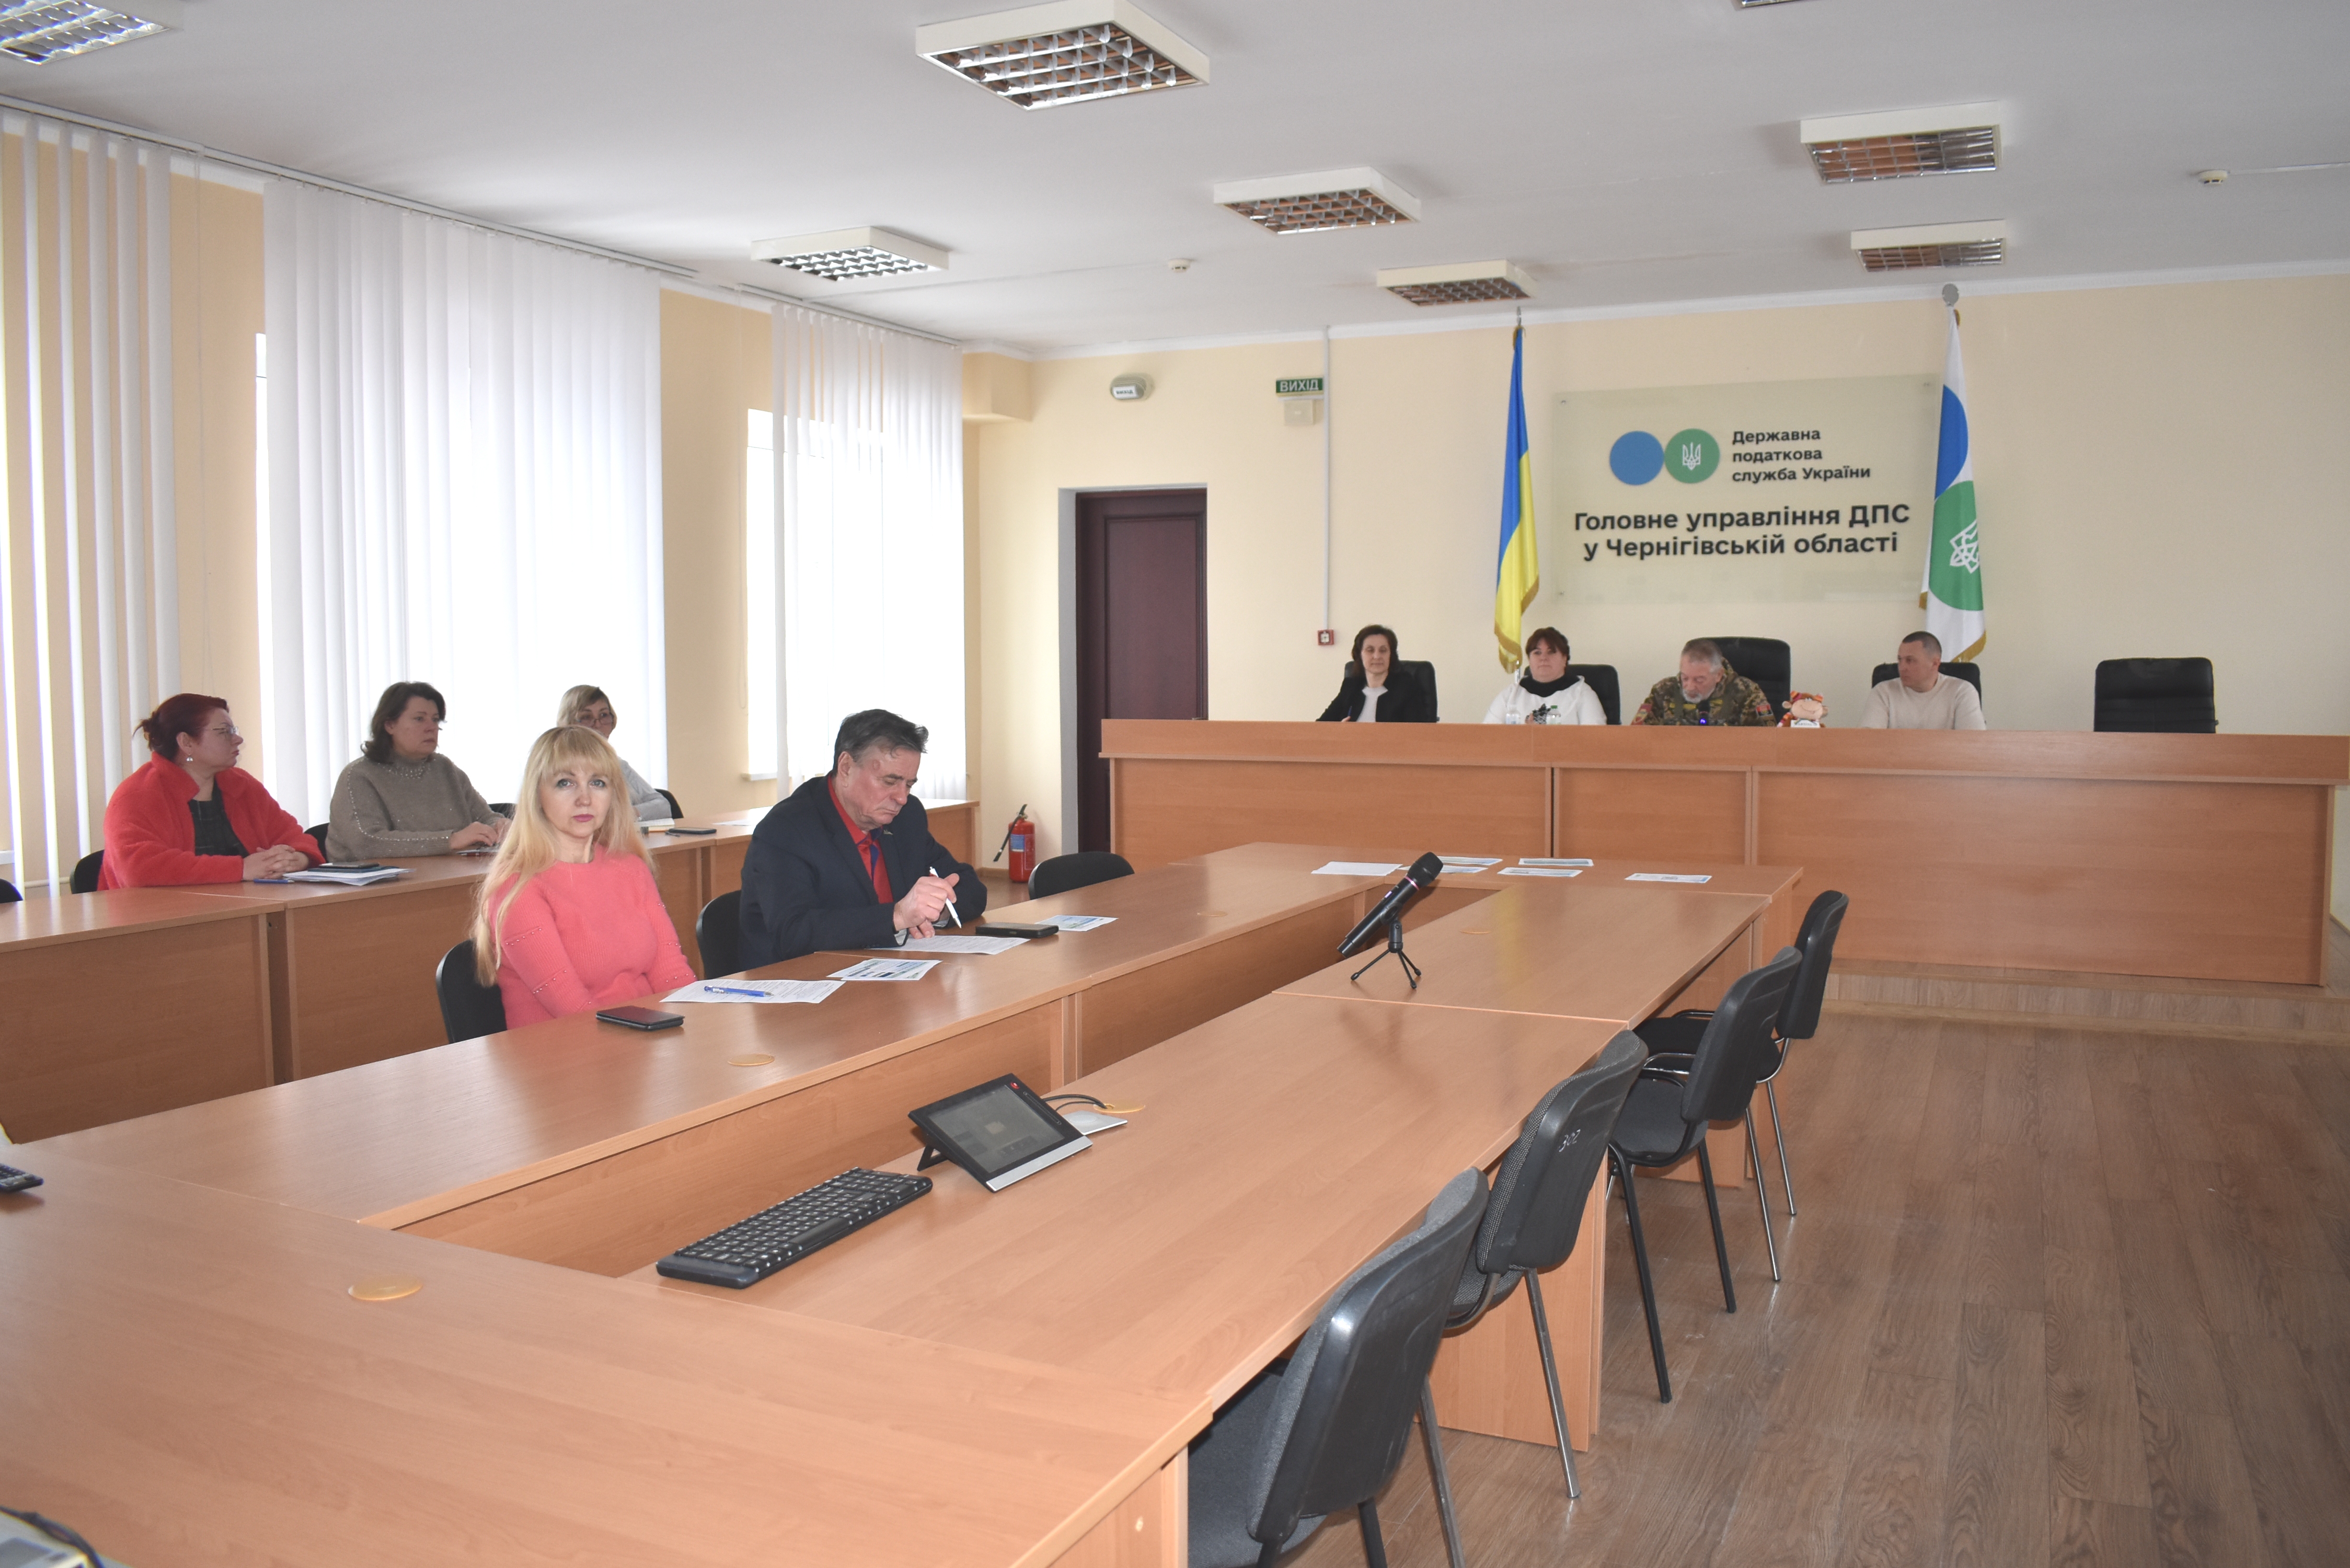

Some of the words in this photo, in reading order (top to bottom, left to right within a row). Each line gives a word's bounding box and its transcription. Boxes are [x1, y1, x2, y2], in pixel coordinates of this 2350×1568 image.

[1280, 379, 1319, 392] ВИХІД
[1732, 429, 1821, 445] Державна
[1732, 449, 1823, 464] податкова
[1732, 467, 1797, 483] служба
[1802, 465, 1871, 481] України
[1574, 512, 1678, 531] Головне
[1686, 505, 1840, 532] управління
[1848, 503, 1910, 528] ДПС
[1584, 541, 1599, 562] у
[1606, 533, 1785, 561] Чернігівській
[1794, 531, 1898, 554] області
